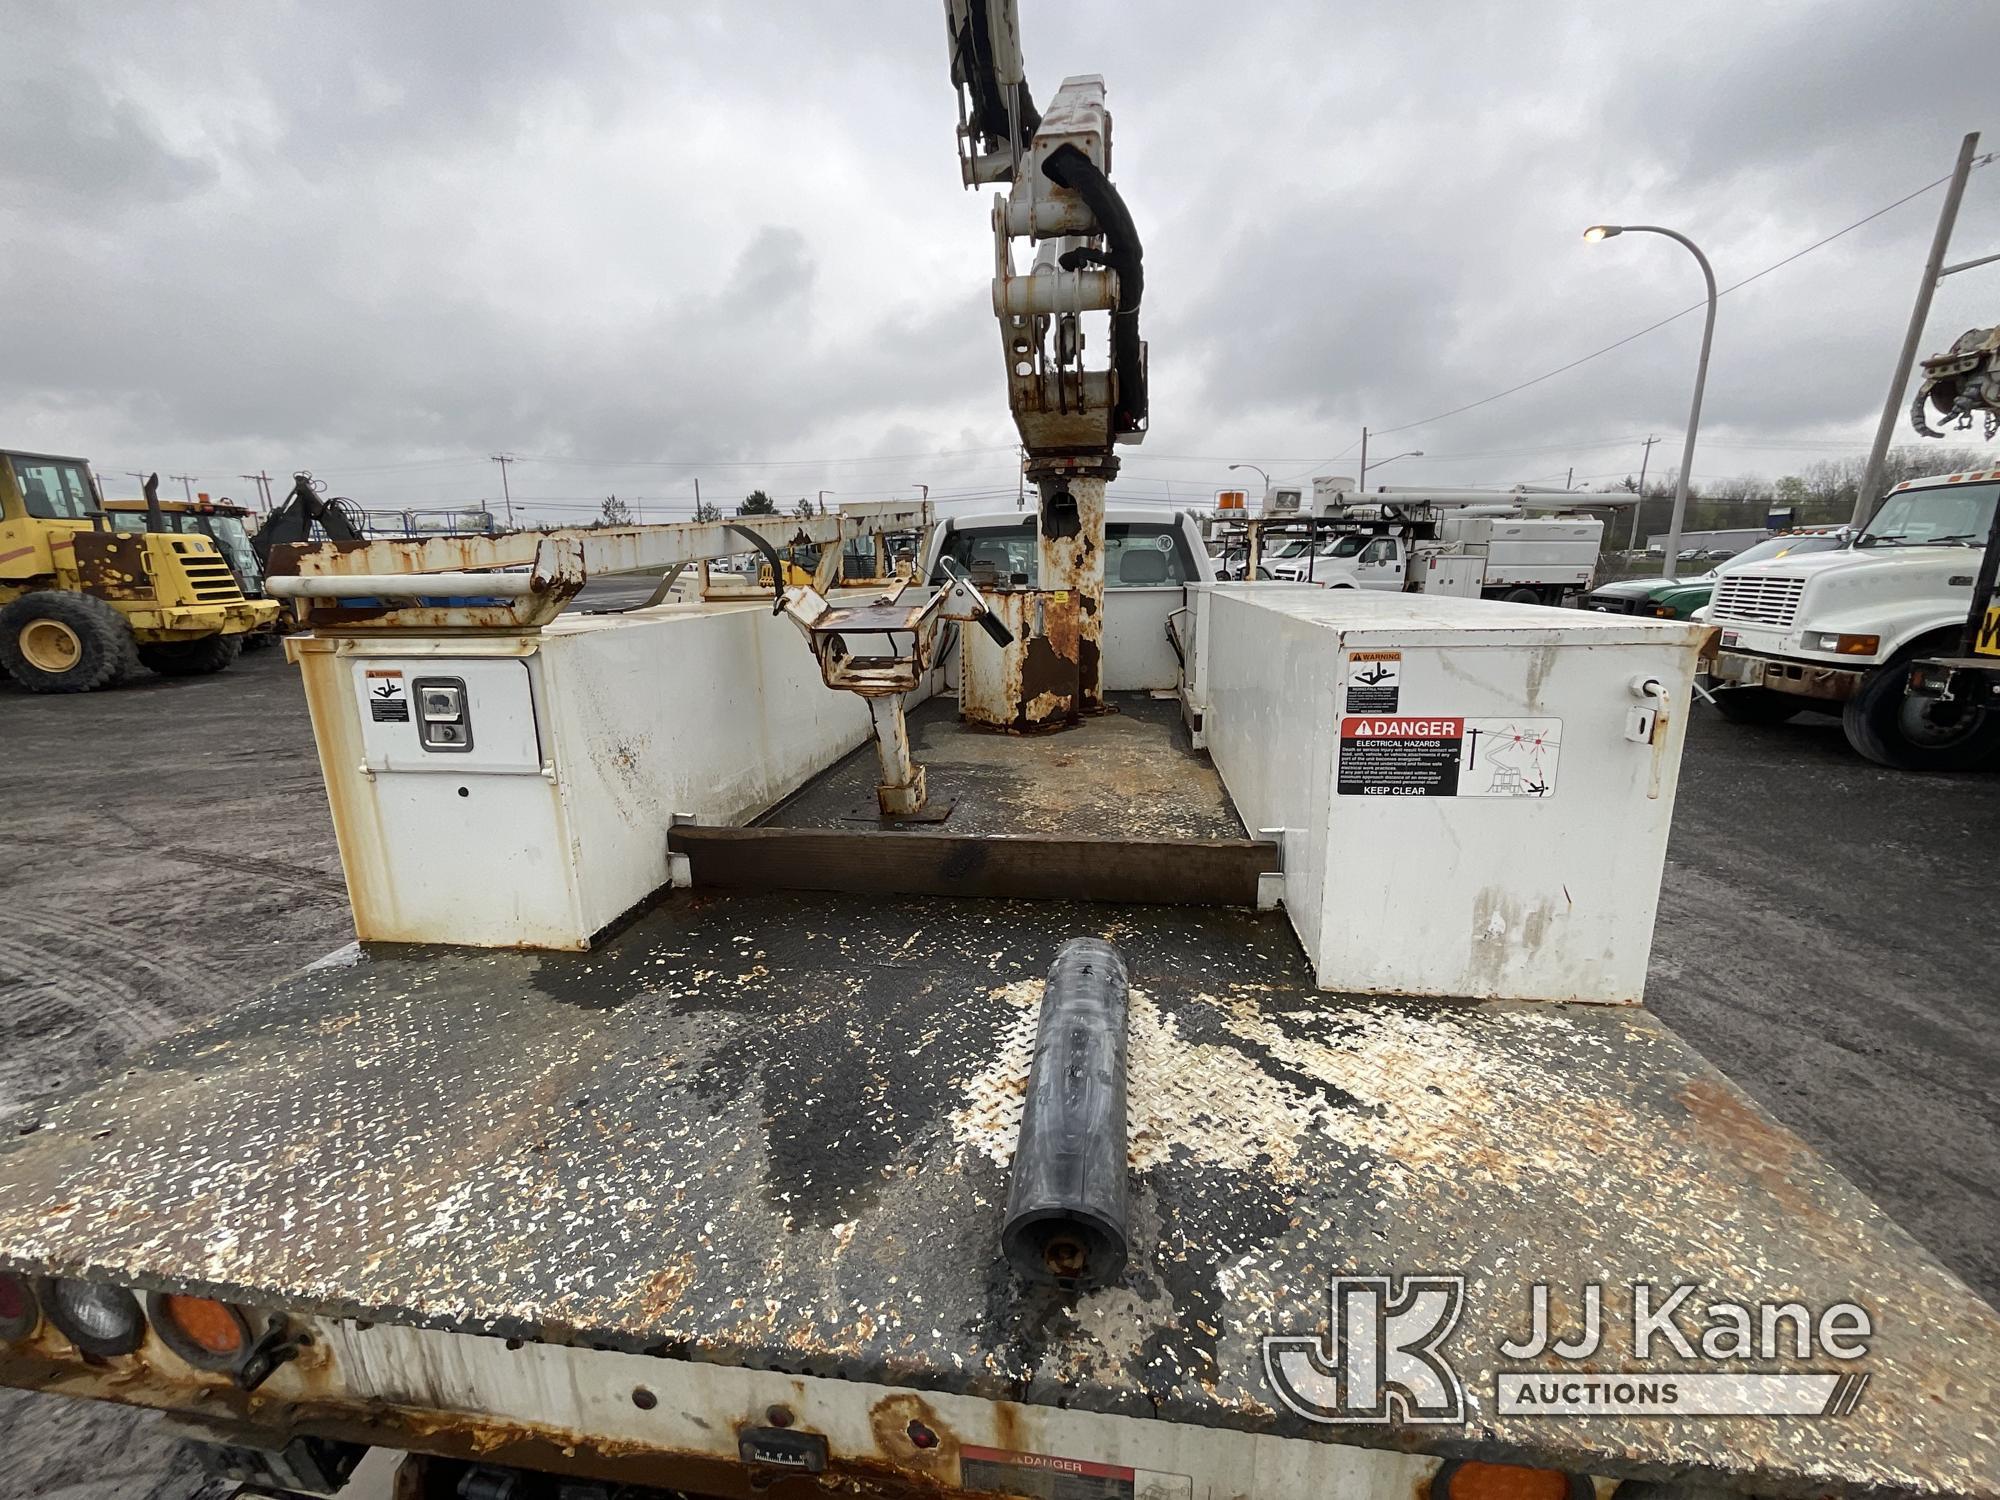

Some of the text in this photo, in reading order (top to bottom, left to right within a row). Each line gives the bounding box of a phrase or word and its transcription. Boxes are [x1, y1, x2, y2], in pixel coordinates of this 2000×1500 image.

[1374, 721, 1456, 736] DANGER
[1364, 786, 1426, 795] KEEP CLEAR
